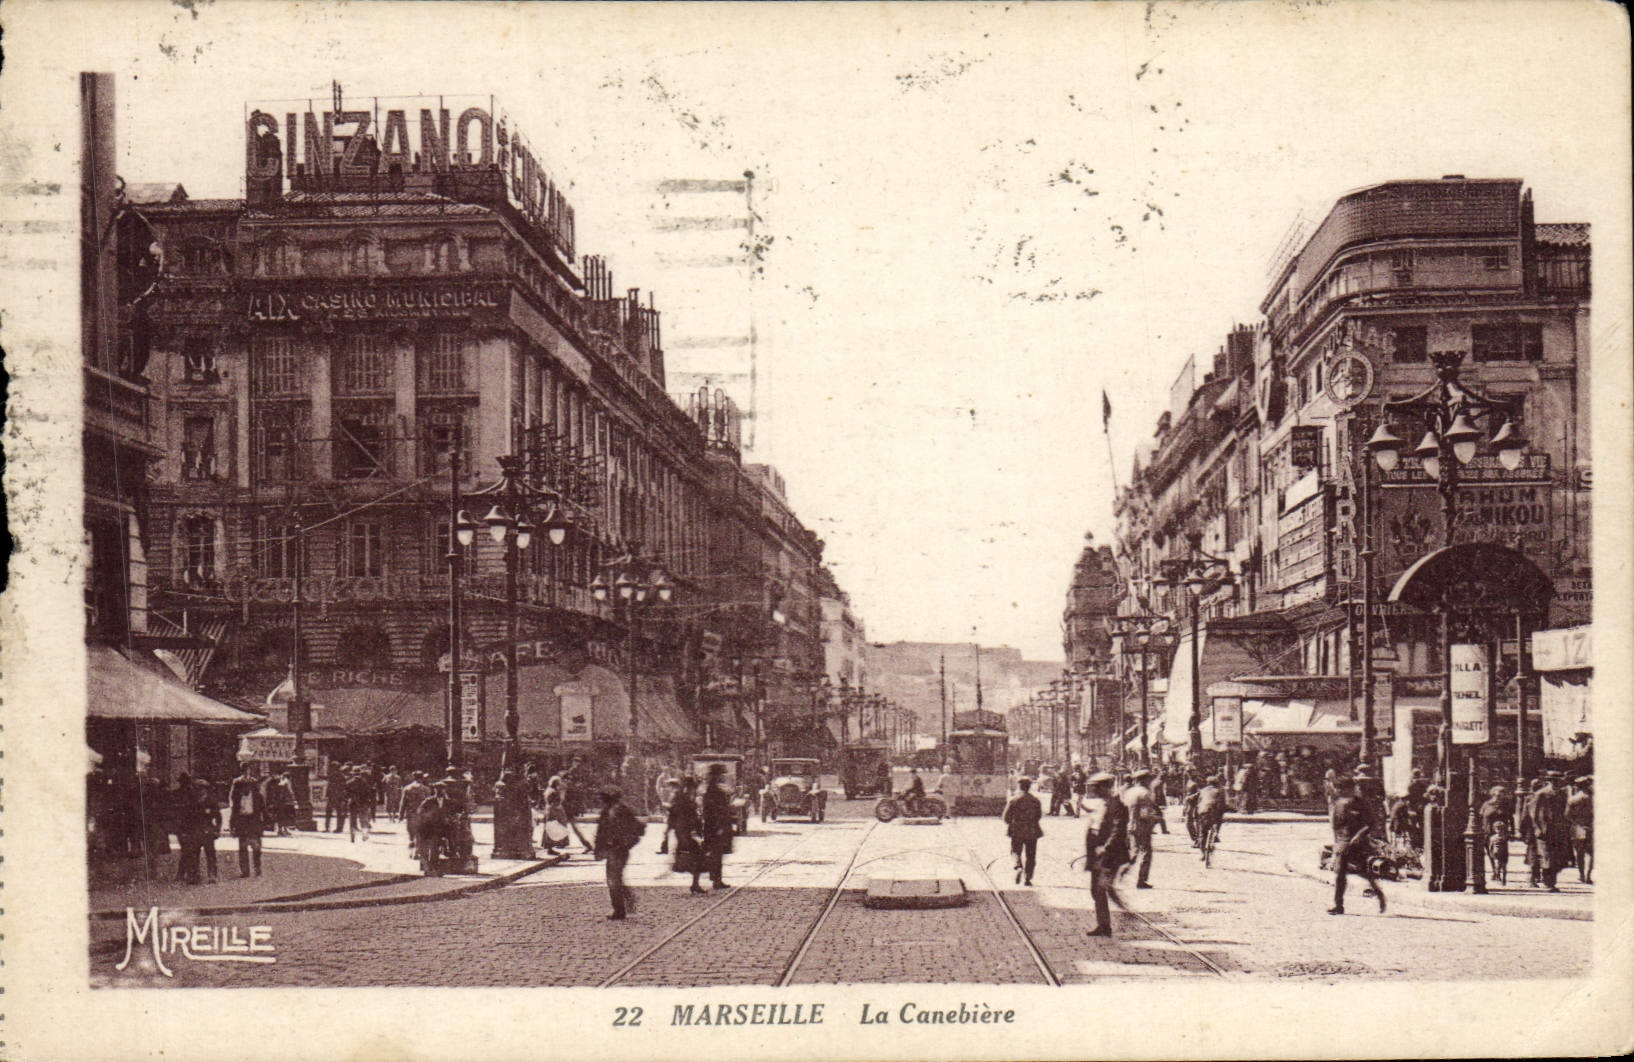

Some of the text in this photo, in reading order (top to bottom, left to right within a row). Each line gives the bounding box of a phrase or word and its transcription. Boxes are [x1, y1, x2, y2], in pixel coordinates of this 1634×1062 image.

[246, 107, 493, 181] CINZANO
[247, 290, 499, 320] AIX CASINO MUNICIPAL
[1458, 488, 1537, 504] RHUM
[332, 671, 404, 685] RICHE
